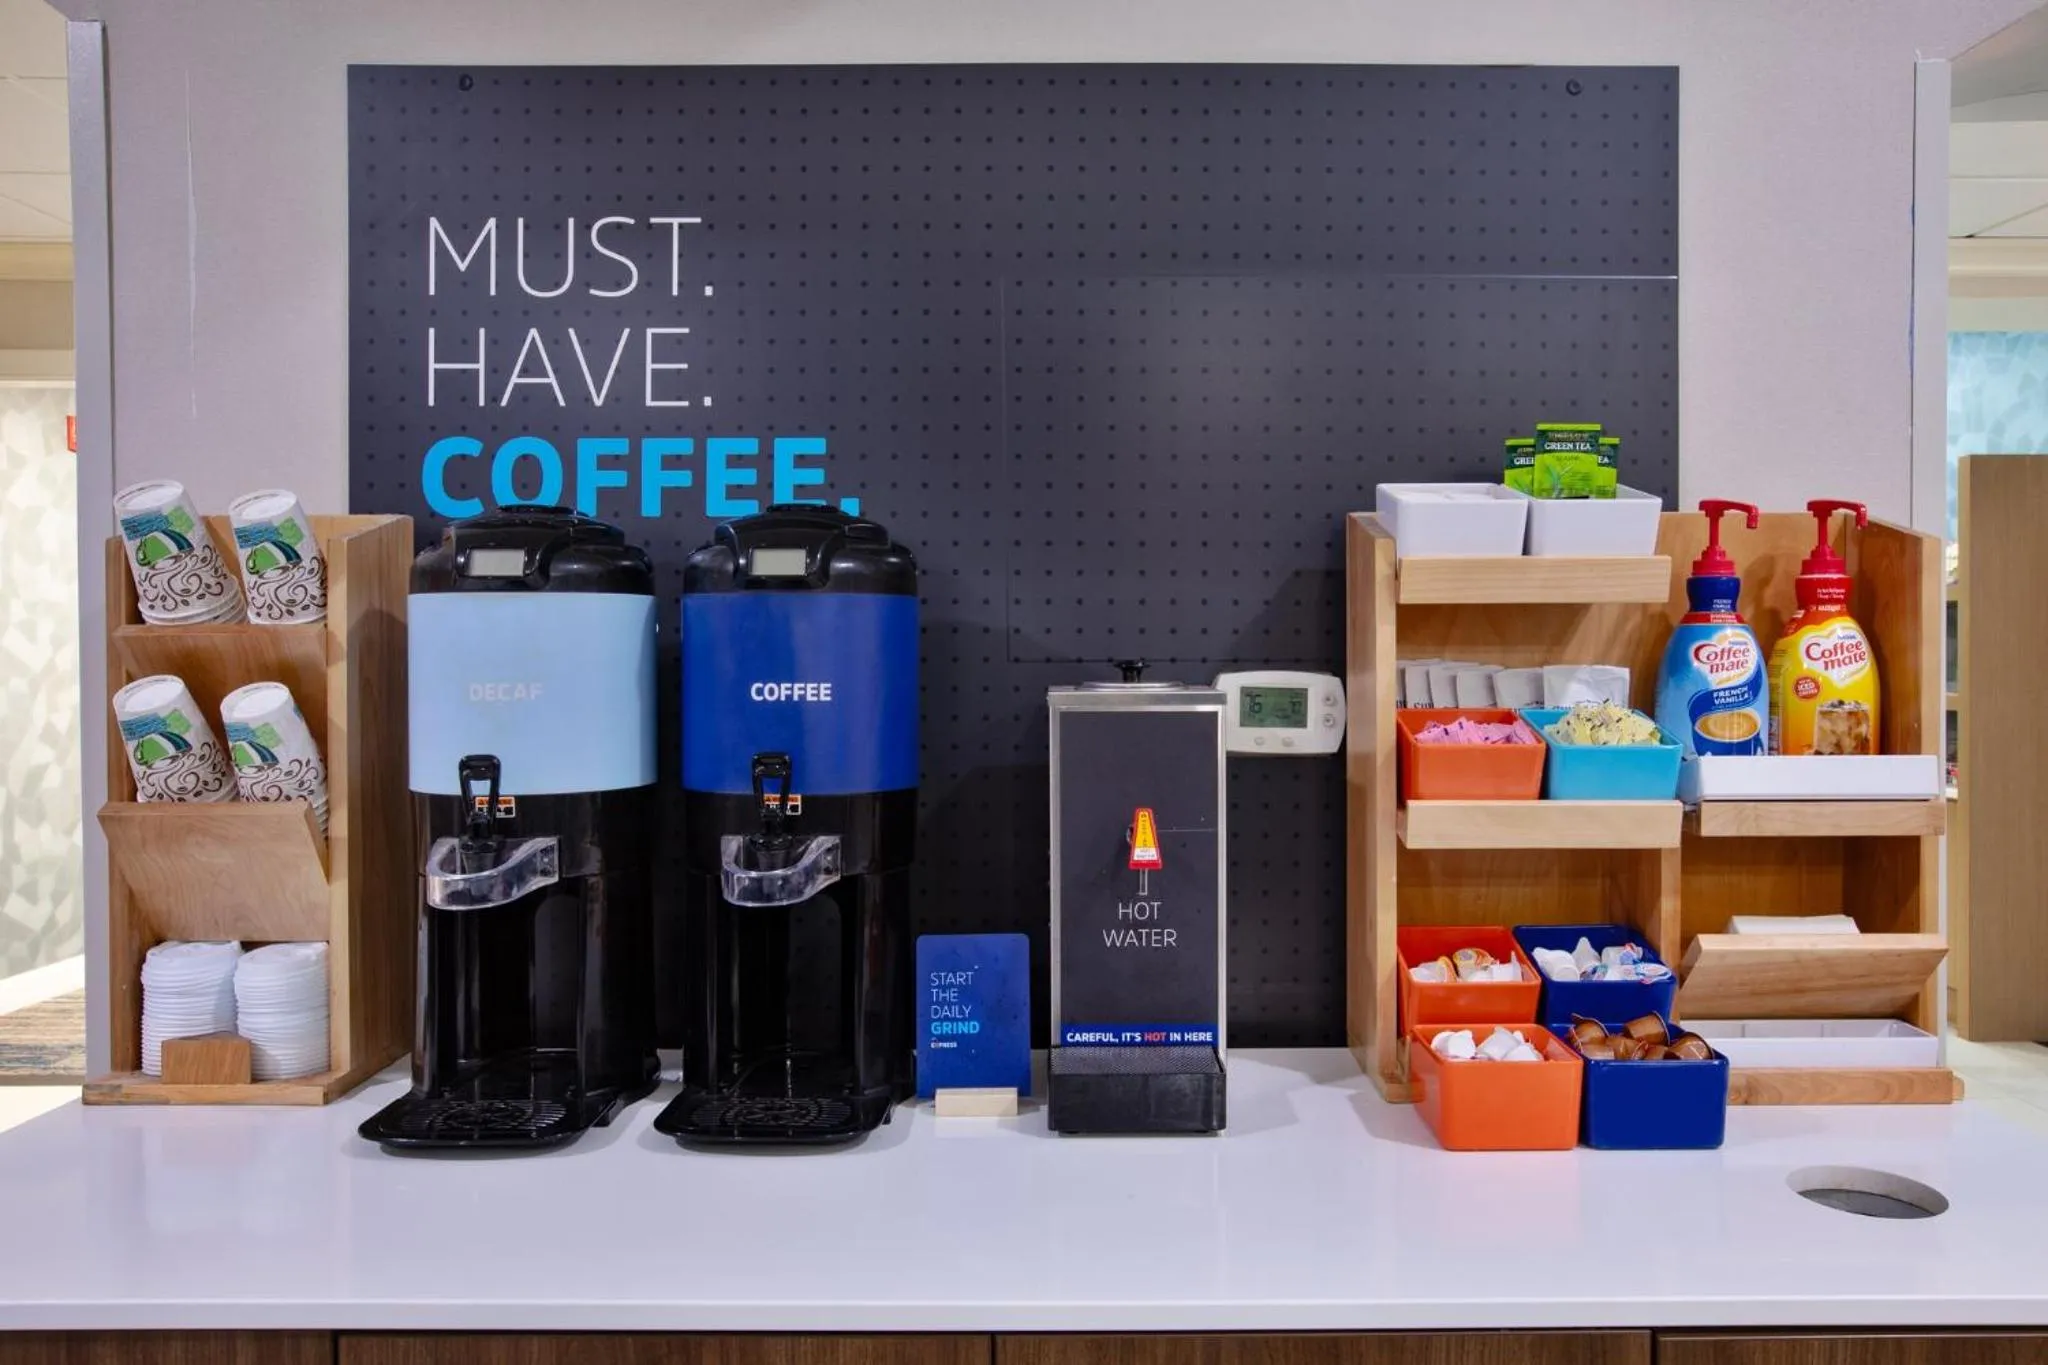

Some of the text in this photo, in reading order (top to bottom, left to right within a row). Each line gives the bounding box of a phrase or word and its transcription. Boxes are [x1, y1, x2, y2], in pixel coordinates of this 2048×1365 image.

[429, 216, 714, 297] MUST.
[428, 327, 713, 407] HAVE.
[1544, 442, 1592, 450] GREEN TEA
[421, 436, 860, 518] COFFEE.
[1694, 643, 1750, 665] Coffee
[1805, 640, 1863, 661] Coffee
[1710, 659, 1749, 674] mate
[1824, 650, 1867, 671] mate
[469, 682, 544, 702] DECAF
[750, 682, 833, 702] COFFEE
[1713, 686, 1749, 697] FRENCH
[1118, 902, 1162, 920] HOT
[1102, 929, 1178, 947] WATER
[930, 971, 974, 986] START
[930, 988, 959, 1002] THE
[930, 1005, 972, 1019] DAILY
[931, 1021, 980, 1035] GRIND
[1066, 1031, 1213, 1043] CAREFUL, IT'S HOT IN HERE
